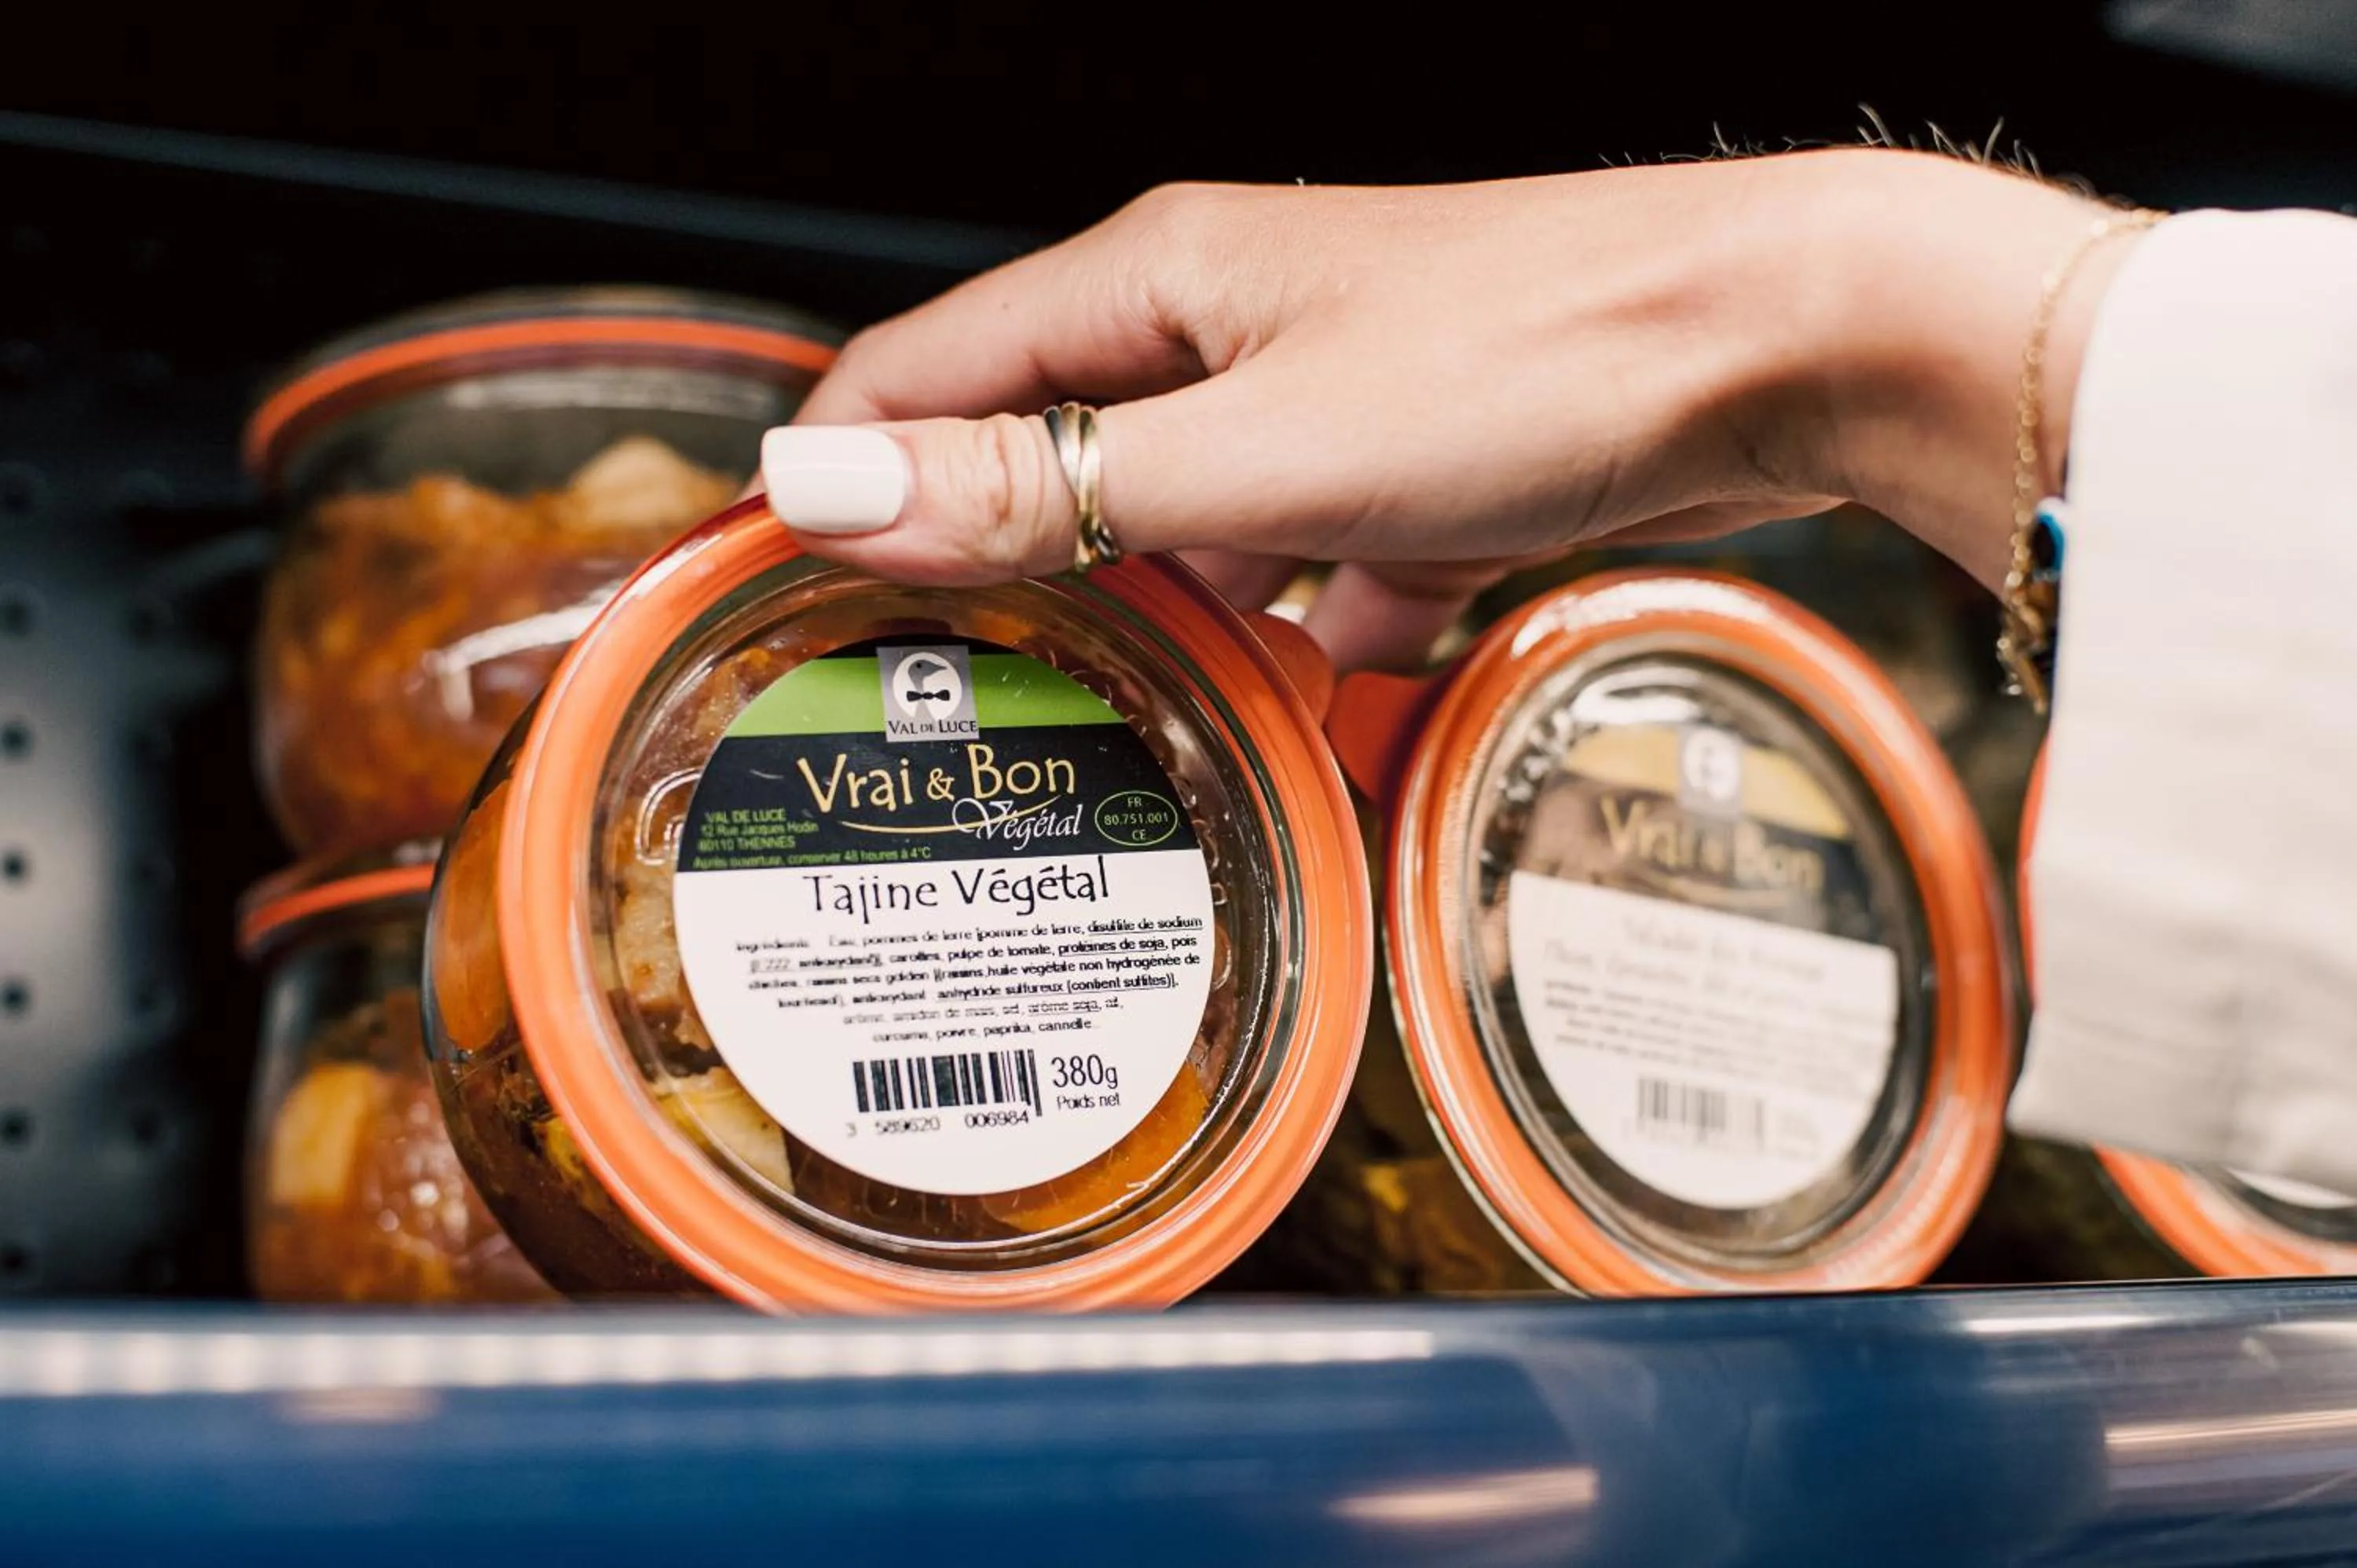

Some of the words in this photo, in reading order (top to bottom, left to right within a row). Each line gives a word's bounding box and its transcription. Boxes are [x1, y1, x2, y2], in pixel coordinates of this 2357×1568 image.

[888, 720, 918, 735] VAL
[938, 720, 977, 733] LUCE
[797, 753, 914, 813] Vrai
[926, 768, 955, 801] &
[965, 744, 1075, 799] Bon
[1127, 797, 1142, 808] FR
[705, 811, 729, 823] VAL
[731, 810, 750, 822] DE
[753, 808, 786, 822] LUCE
[951, 797, 1083, 850] Végétal
[1104, 814, 1169, 826] 80.751.001
[1131, 830, 1146, 841] CE
[803, 874, 939, 925] Tajine
[951, 855, 1109, 916] Végétal
[922, 931, 939, 942] de
[1032, 923, 1048, 936] de
[1138, 918, 1155, 929] de
[1157, 915, 1203, 929] sodium
[948, 948, 983, 962] pulpe
[988, 944, 1004, 958] de
[1120, 937, 1135, 951] de
[1171, 934, 1197, 947] pois
[1079, 960, 1103, 971] non
[1184, 951, 1200, 964] de
[1051, 1054, 1119, 1089] 380g
[1057, 1094, 1095, 1110] Poids
[1100, 1092, 1120, 1107] net
[964, 1110, 1030, 1129] 006984
